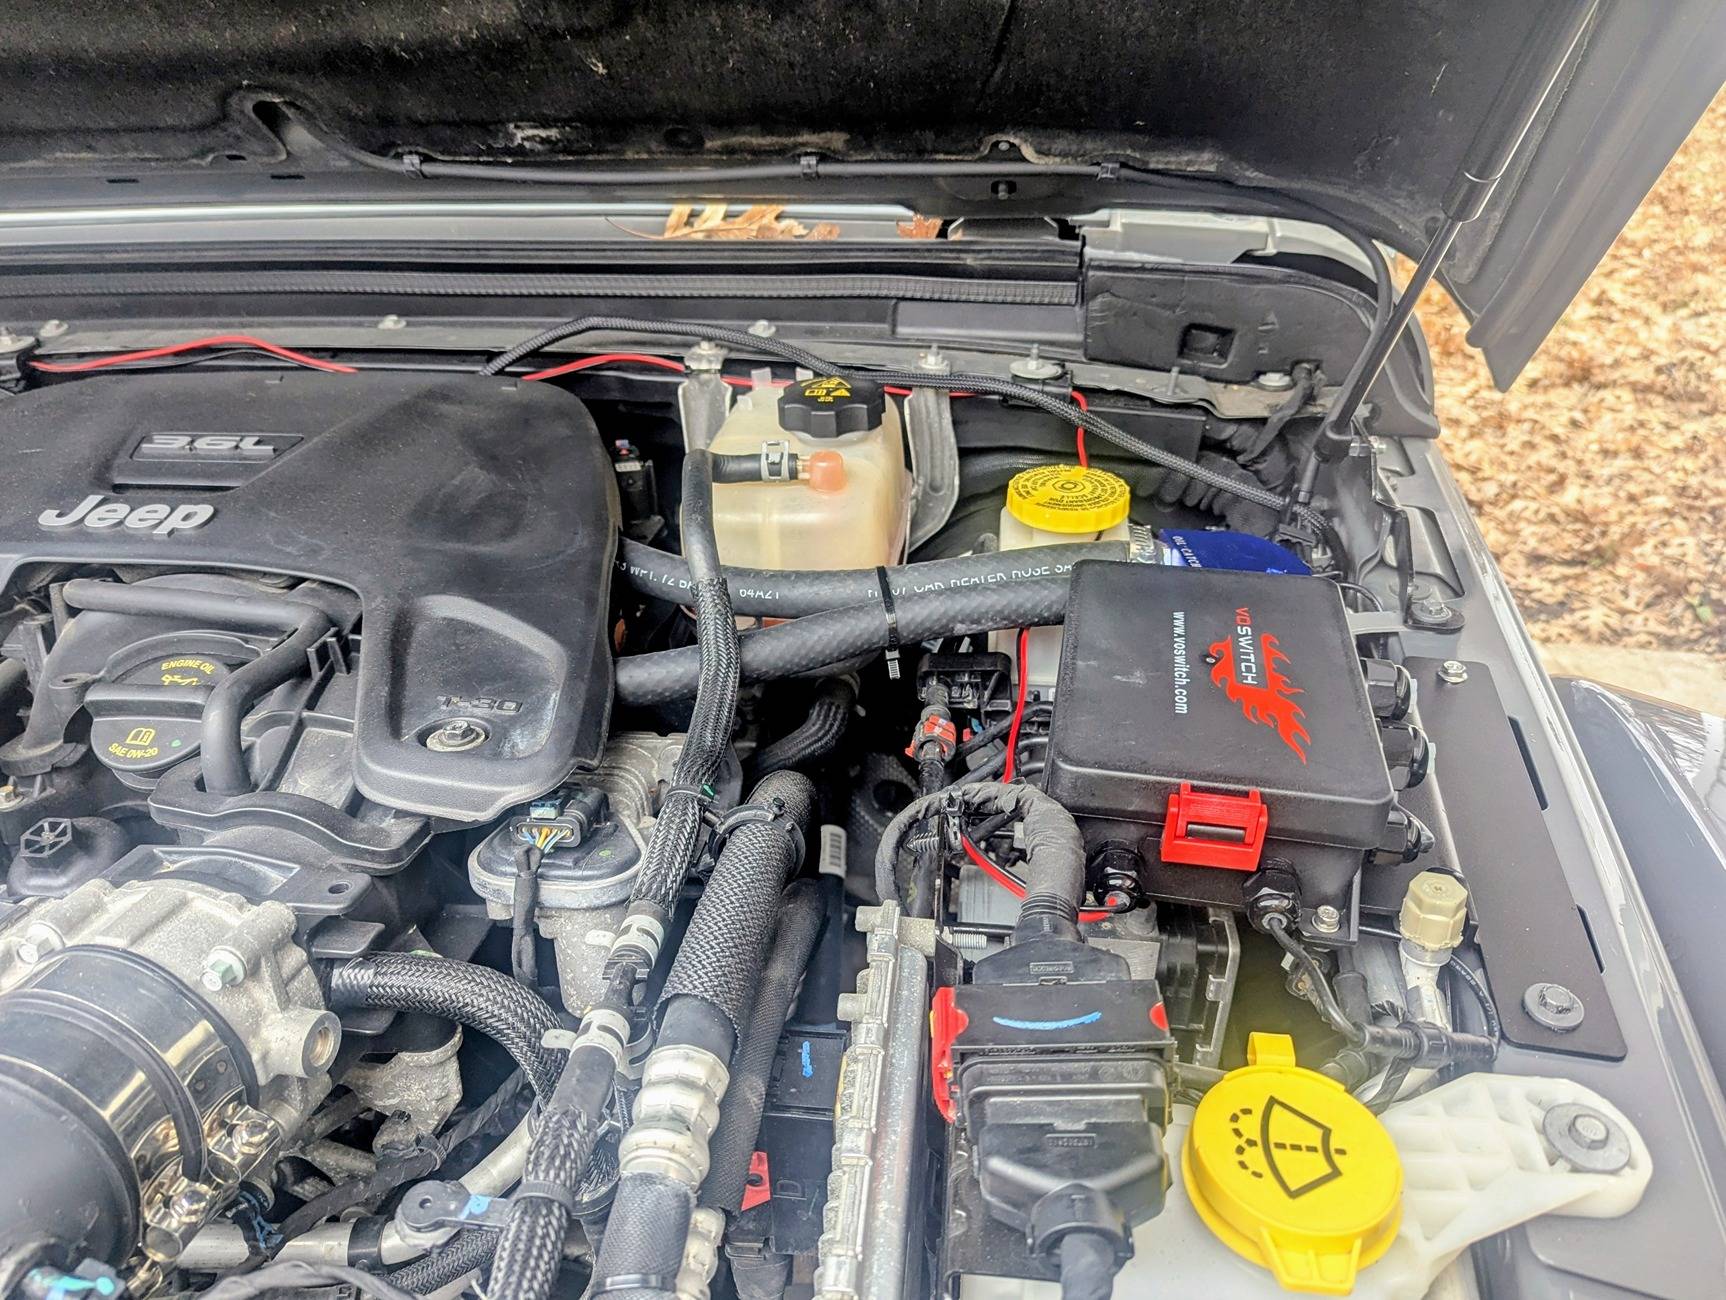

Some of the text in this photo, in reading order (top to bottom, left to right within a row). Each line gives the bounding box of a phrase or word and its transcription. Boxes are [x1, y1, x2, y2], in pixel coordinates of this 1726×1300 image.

[38, 494, 216, 537] Jeep
[161, 659, 215, 675] ENGINE OIL
[1173, 611, 1190, 714] www.voswitch.com
[1235, 607, 1258, 685] VOSWITCH
[108, 742, 159, 758] SAE 0W-20
